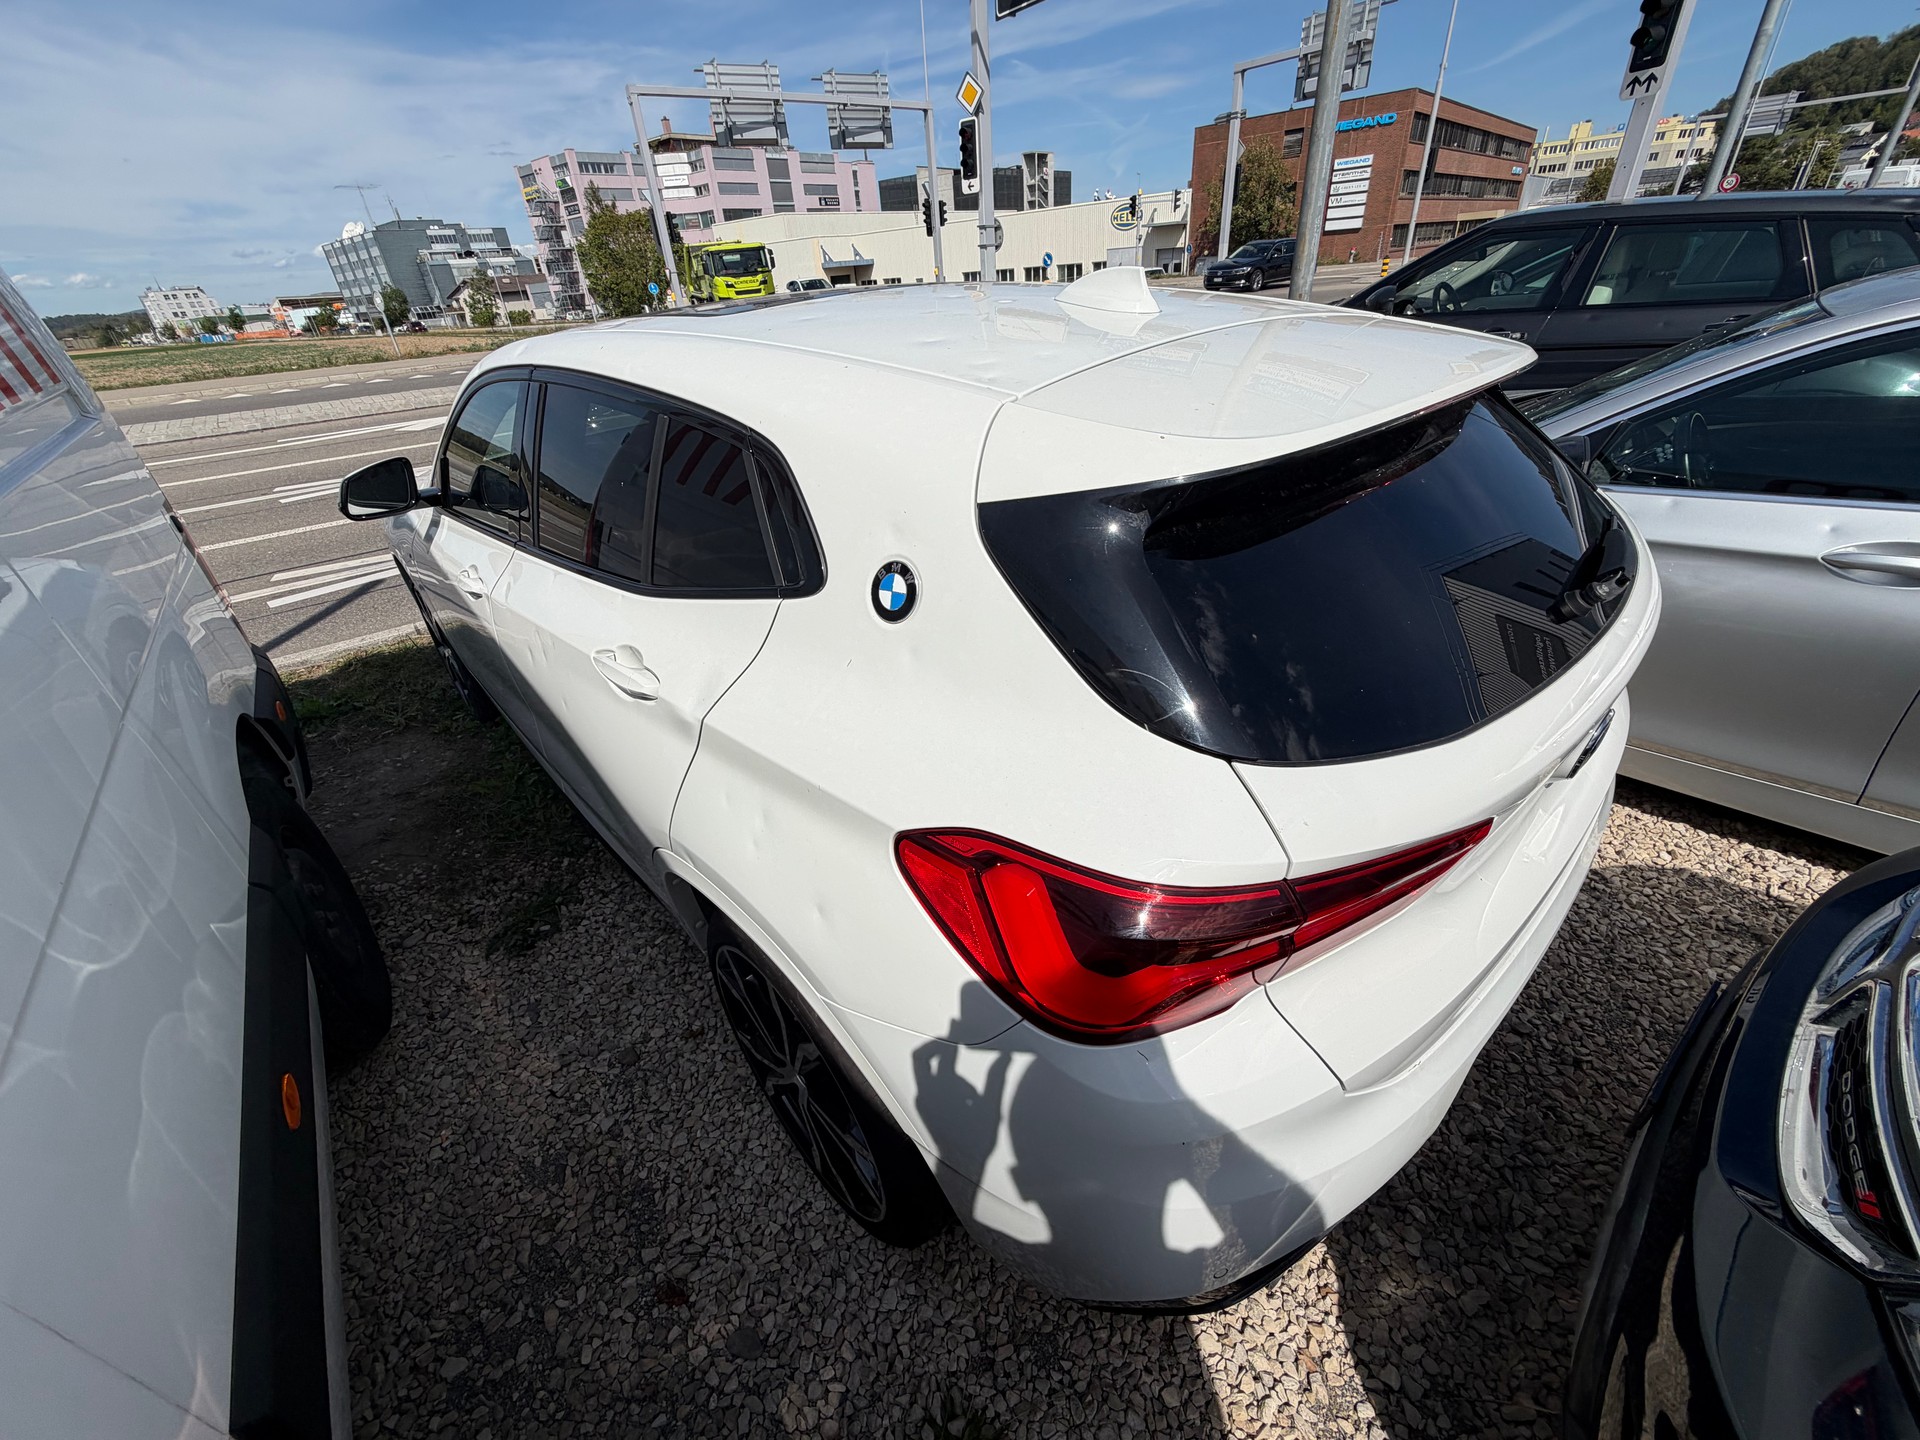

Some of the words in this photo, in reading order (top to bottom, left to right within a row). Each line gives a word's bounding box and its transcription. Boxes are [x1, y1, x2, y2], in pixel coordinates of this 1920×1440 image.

[1335, 113, 1397, 131] IEGAND
[1337, 157, 1370, 166] WIEGAND
[1725, 179, 1734, 187] 50
[877, 562, 915, 584] BMW
[1842, 1070, 1869, 1200] DODGE
